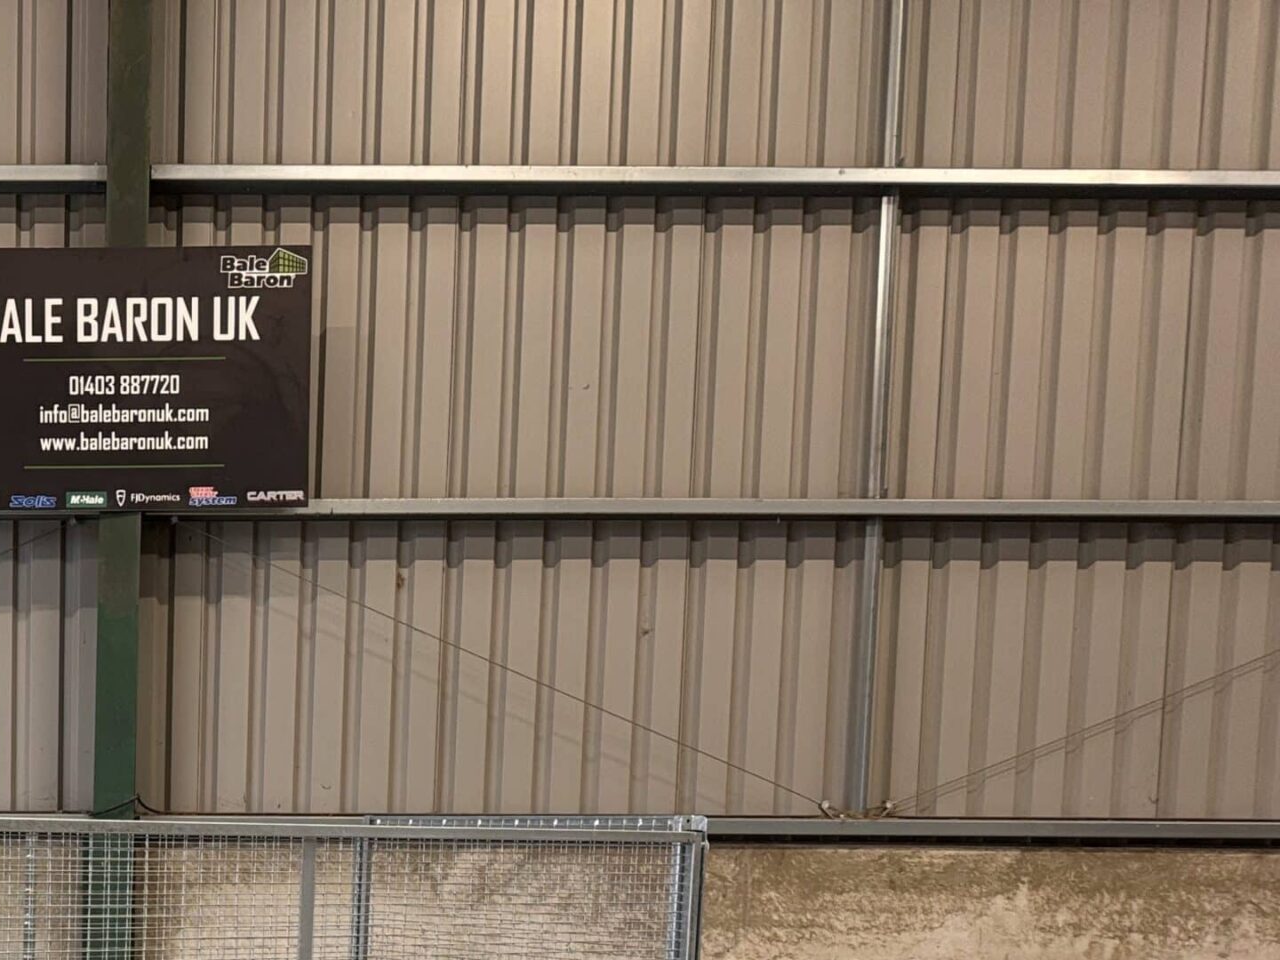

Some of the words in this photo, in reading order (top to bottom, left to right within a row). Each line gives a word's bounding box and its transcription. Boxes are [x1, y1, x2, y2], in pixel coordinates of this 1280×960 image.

[220, 255, 269, 273] Bale
[228, 272, 295, 288] Baron
[76, 297, 199, 342] BARON
[213, 296, 260, 341] UK
[69, 375, 115, 395] 01403
[120, 375, 180, 394] 887720
[39, 403, 209, 424] info@balebaronuk.com
[40, 431, 208, 451] www.balebaronuk.com
[247, 490, 304, 501] CARTER
